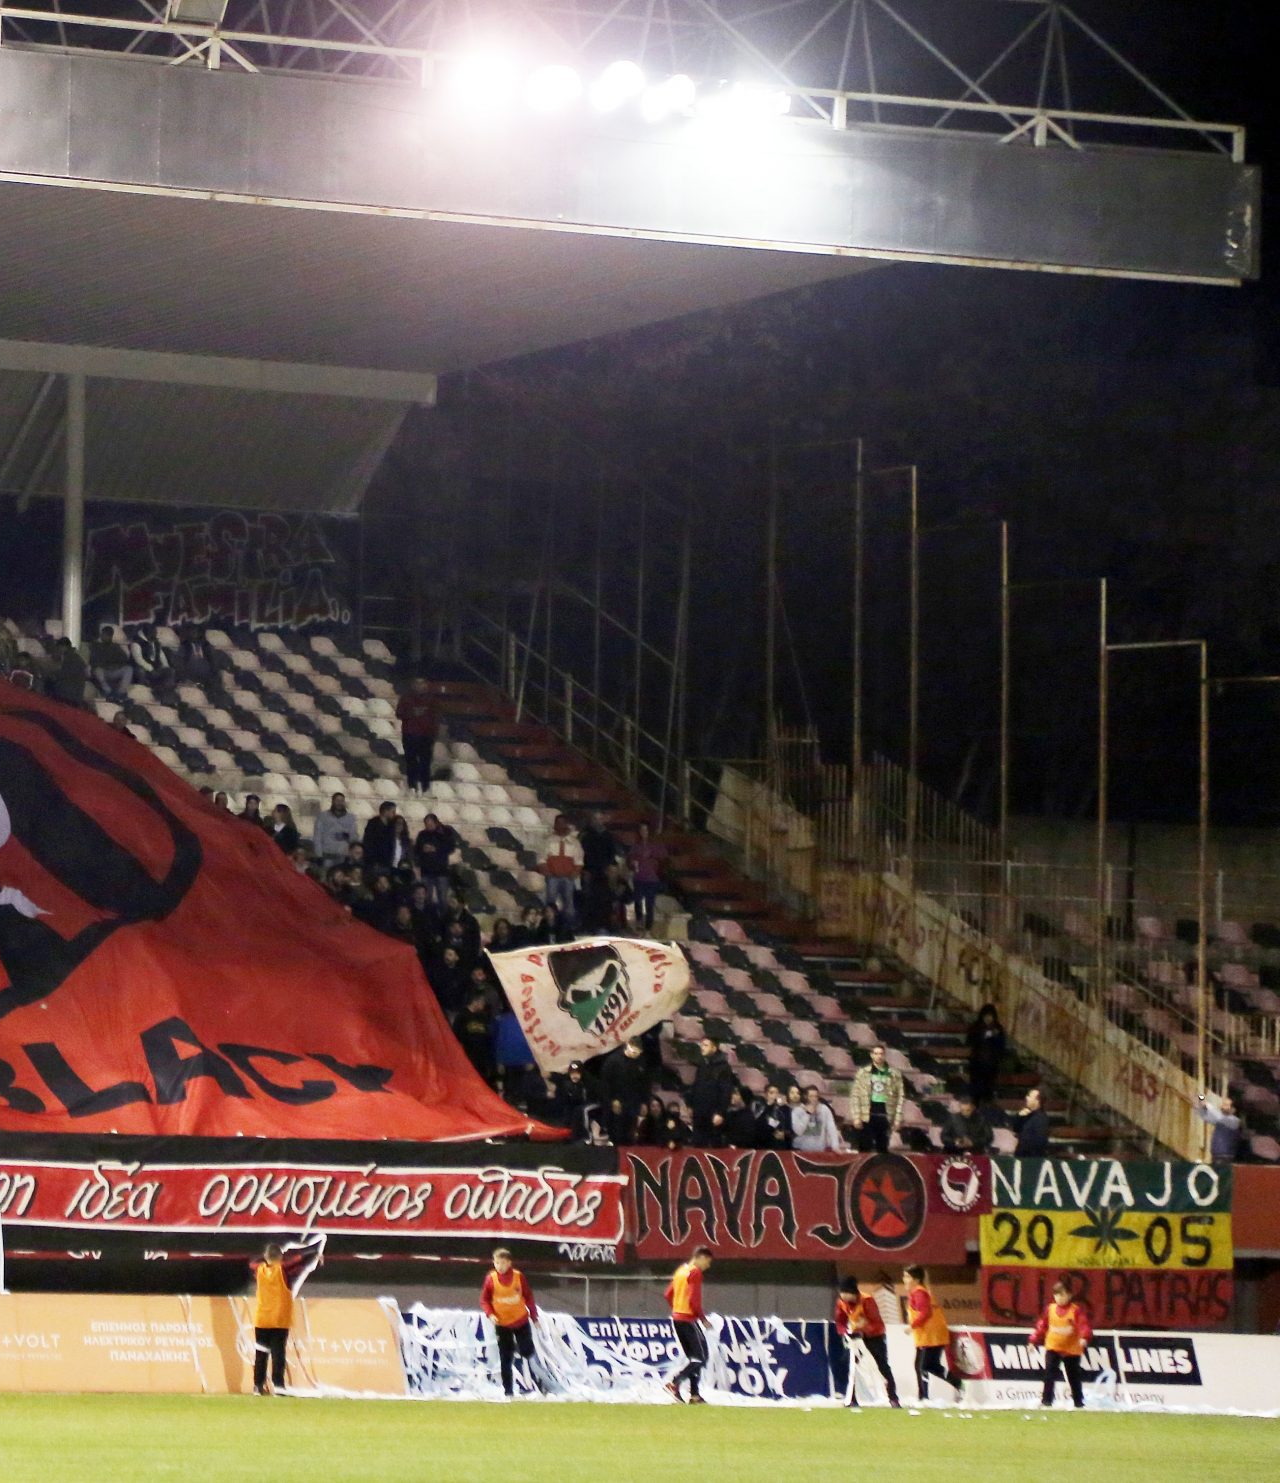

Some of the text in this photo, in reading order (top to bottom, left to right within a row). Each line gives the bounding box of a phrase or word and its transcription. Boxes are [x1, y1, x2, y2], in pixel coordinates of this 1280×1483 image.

[594, 982, 629, 1034] 1891
[66, 1160, 160, 1221] ιδέα
[199, 1162, 431, 1242] ορκισμένος
[444, 1167, 603, 1227] οπαδός
[990, 1159, 1219, 1208] NAVAJO
[993, 1212, 1215, 1267] 20 05
[587, 1321, 678, 1338] ΕΠΙΧΕΙΡΗ
[990, 1344, 1193, 1374] MINAN LINES
